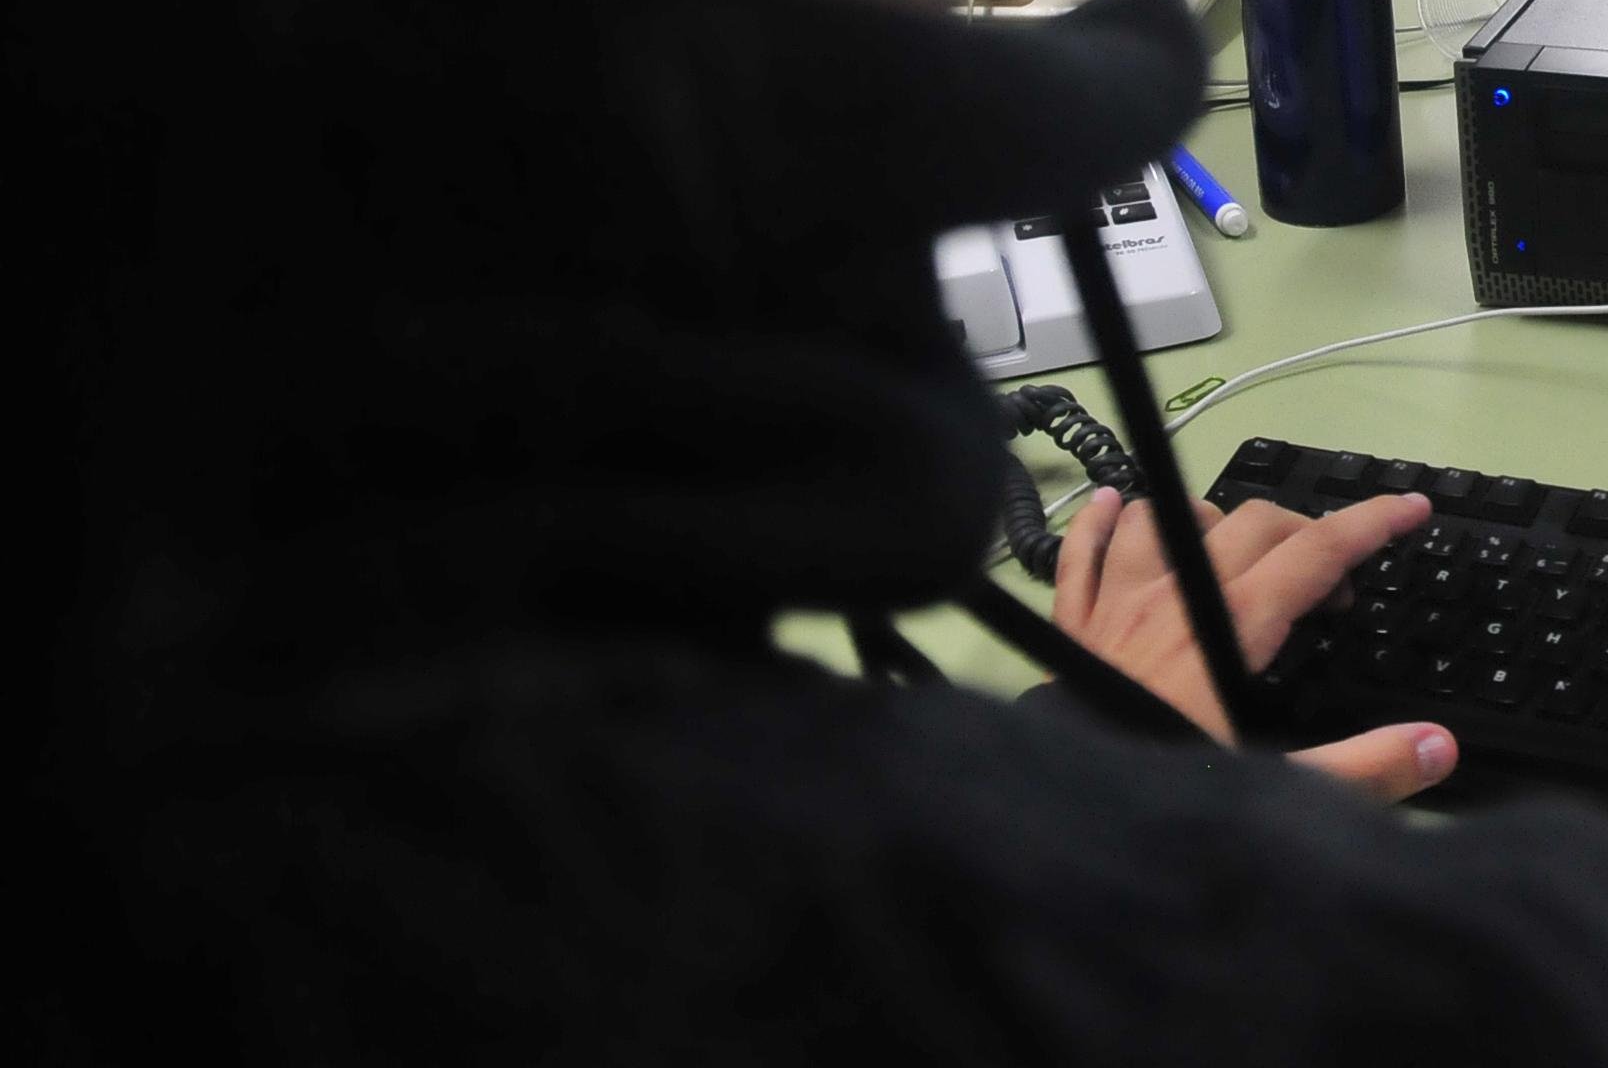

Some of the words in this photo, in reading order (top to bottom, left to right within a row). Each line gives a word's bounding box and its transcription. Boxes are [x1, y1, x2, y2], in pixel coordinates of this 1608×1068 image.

[1105, 235, 1165, 251] telbras
[1393, 461, 1406, 471] F2
[1447, 469, 1460, 479] F3
[1594, 491, 1607, 501] F5
[1379, 560, 1393, 572] E
[1536, 559, 1547, 568] 6
[1435, 569, 1450, 582] R
[1496, 579, 1509, 591] T
[1554, 589, 1570, 601] Y
[1487, 622, 1503, 635] G
[1546, 631, 1563, 645] H
[1435, 660, 1451, 673] V
[1492, 669, 1508, 683] B
